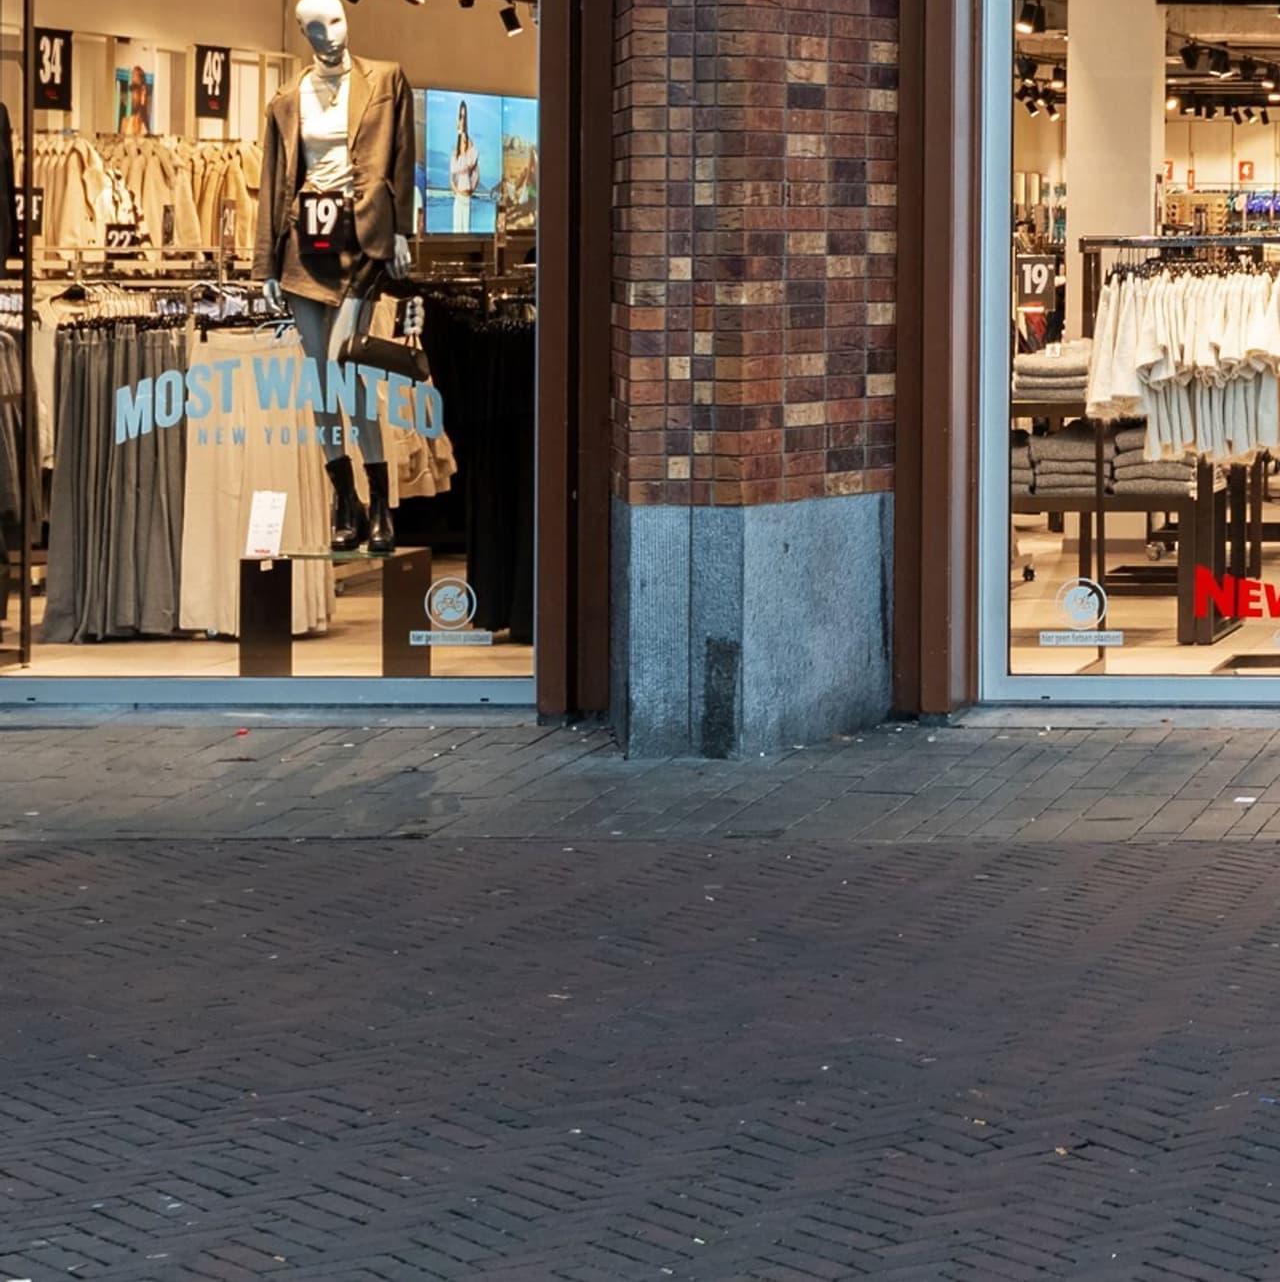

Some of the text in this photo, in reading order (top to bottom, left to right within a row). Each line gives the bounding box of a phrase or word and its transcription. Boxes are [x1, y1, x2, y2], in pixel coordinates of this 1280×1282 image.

[39, 36, 61, 85] 34
[202, 50, 223, 96] 49
[305, 198, 337, 236] 19
[1021, 264, 1050, 295] 19
[115, 356, 444, 445] MOST WANTED
[197, 426, 245, 446] NEW
